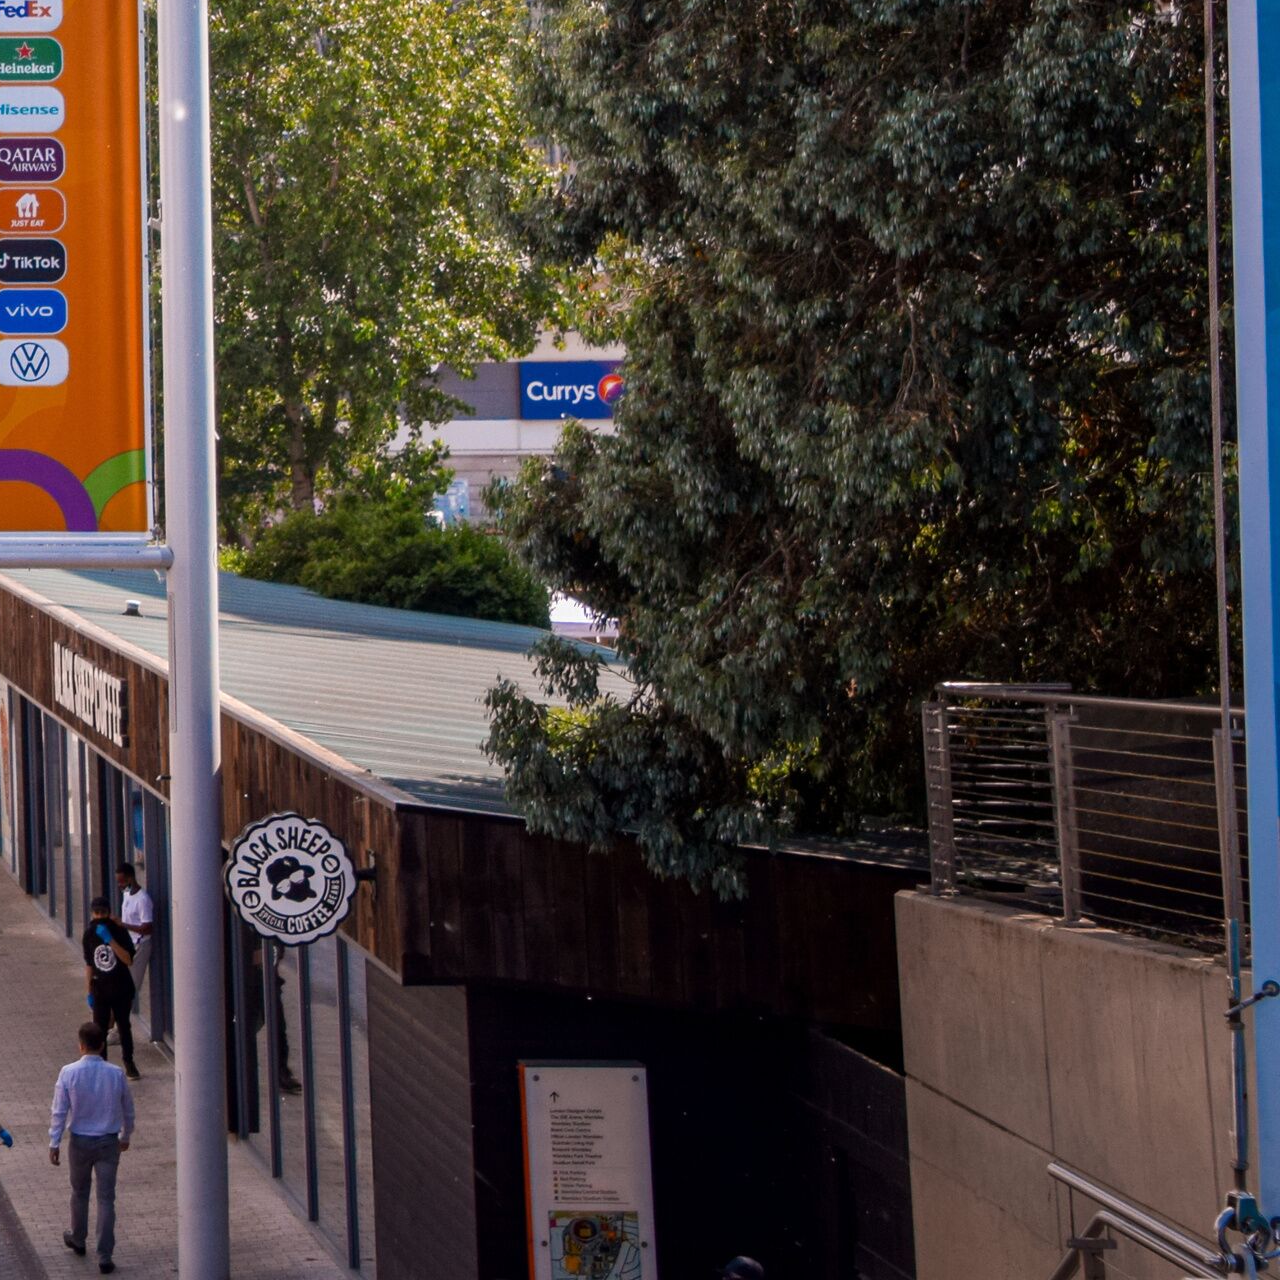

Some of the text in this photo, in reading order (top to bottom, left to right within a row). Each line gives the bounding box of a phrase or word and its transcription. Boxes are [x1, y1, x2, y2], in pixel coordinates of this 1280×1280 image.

[11, 161, 57, 173] AIRWAYS
[11, 219, 45, 228] JUST EAT
[12, 255, 60, 270] TikTok
[5, 304, 53, 318] vivo
[526, 381, 595, 404] Currys
[238, 826, 331, 888] BLACK SHEEP
[258, 880, 340, 933] SPECIAL COFFEE BEANS
